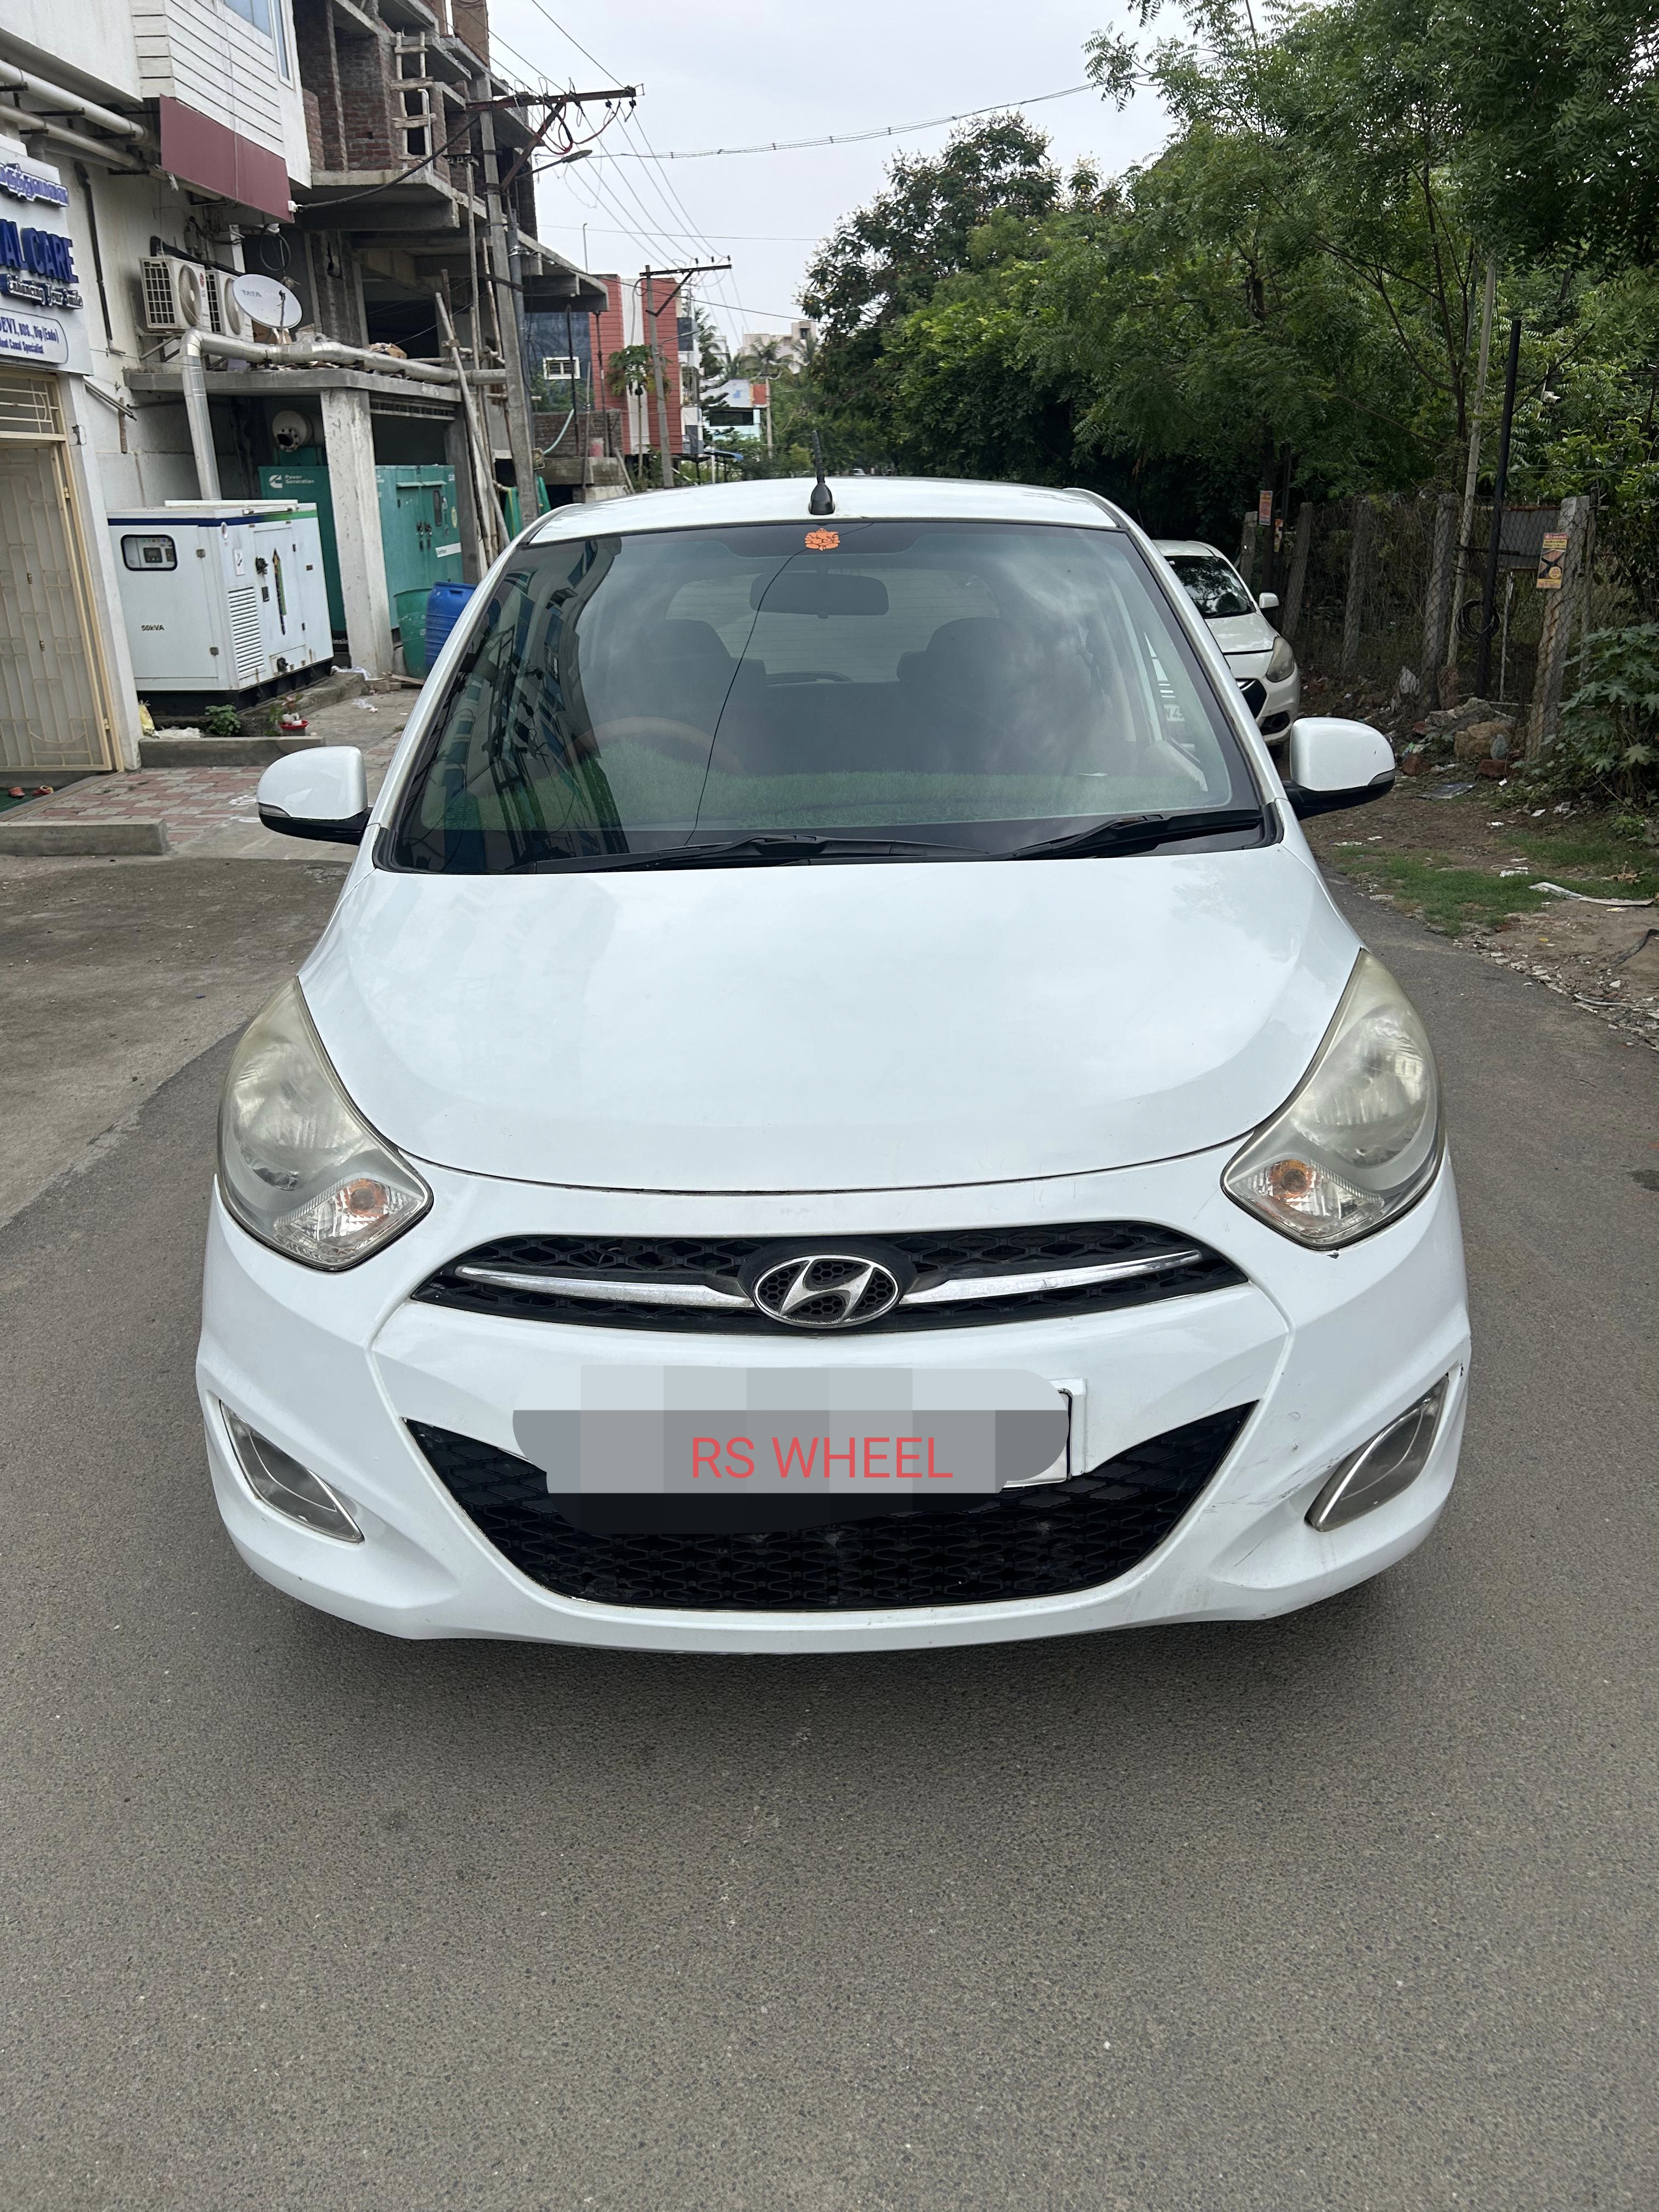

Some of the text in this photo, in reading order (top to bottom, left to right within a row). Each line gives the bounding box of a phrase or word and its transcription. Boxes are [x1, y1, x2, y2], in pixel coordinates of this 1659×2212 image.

[0, 219, 79, 284] AL CARE
[63, 289, 83, 309] Smile
[241, 289, 262, 297] TATA
[0, 317, 20, 336] EVI,
